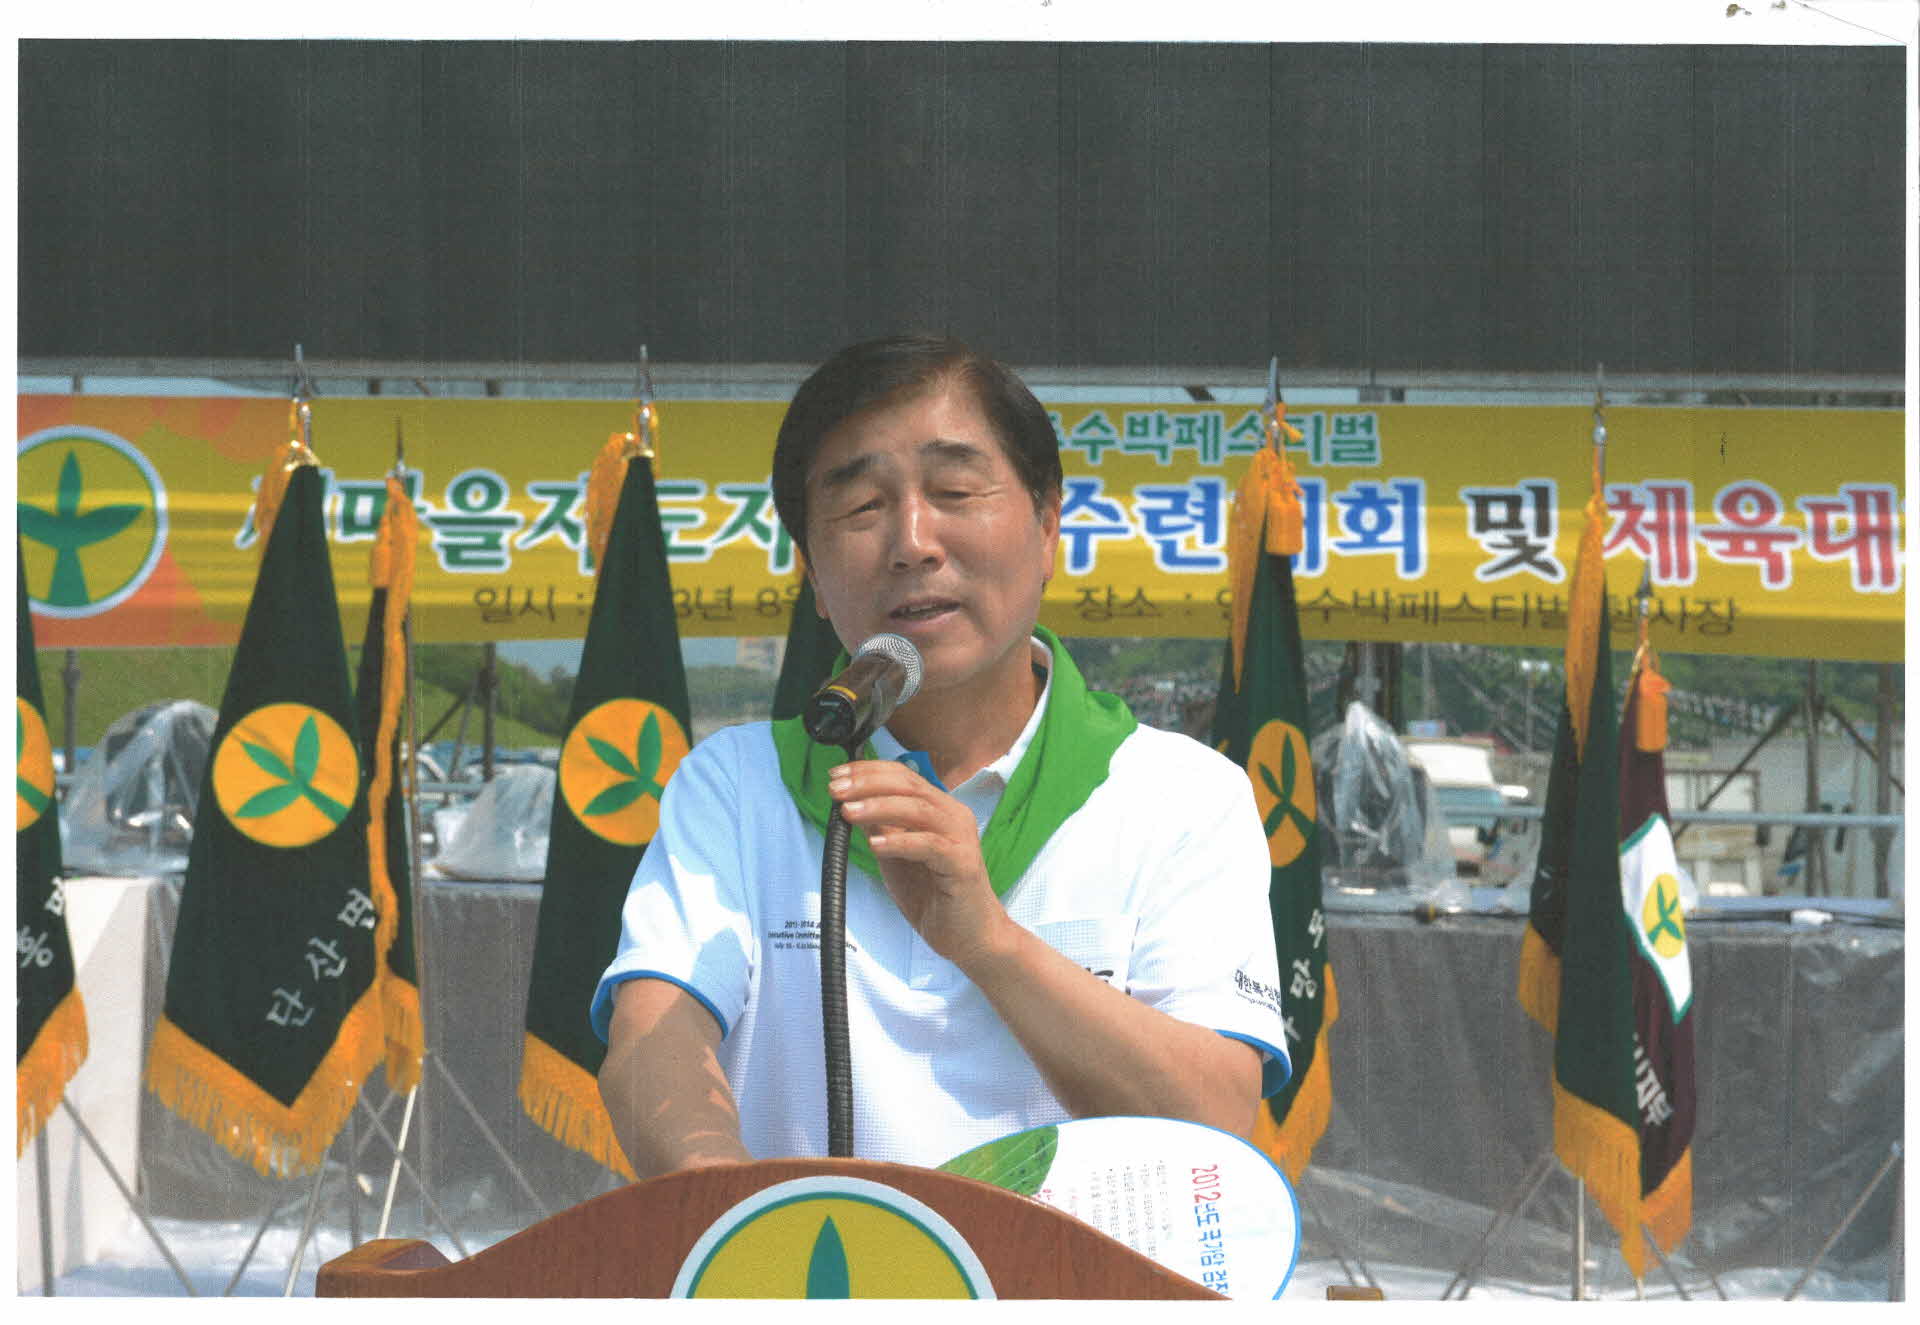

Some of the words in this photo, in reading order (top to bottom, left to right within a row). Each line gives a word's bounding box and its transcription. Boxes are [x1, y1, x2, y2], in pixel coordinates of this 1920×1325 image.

[1057, 410, 1381, 465] 수박페스티벌
[1460, 478, 1566, 582] 및
[1602, 480, 1906, 592] 체육대
[473, 586, 556, 623] 일시
[1074, 585, 1162, 622] 장소
[1215, 586, 1569, 630] 수박페스티벌
